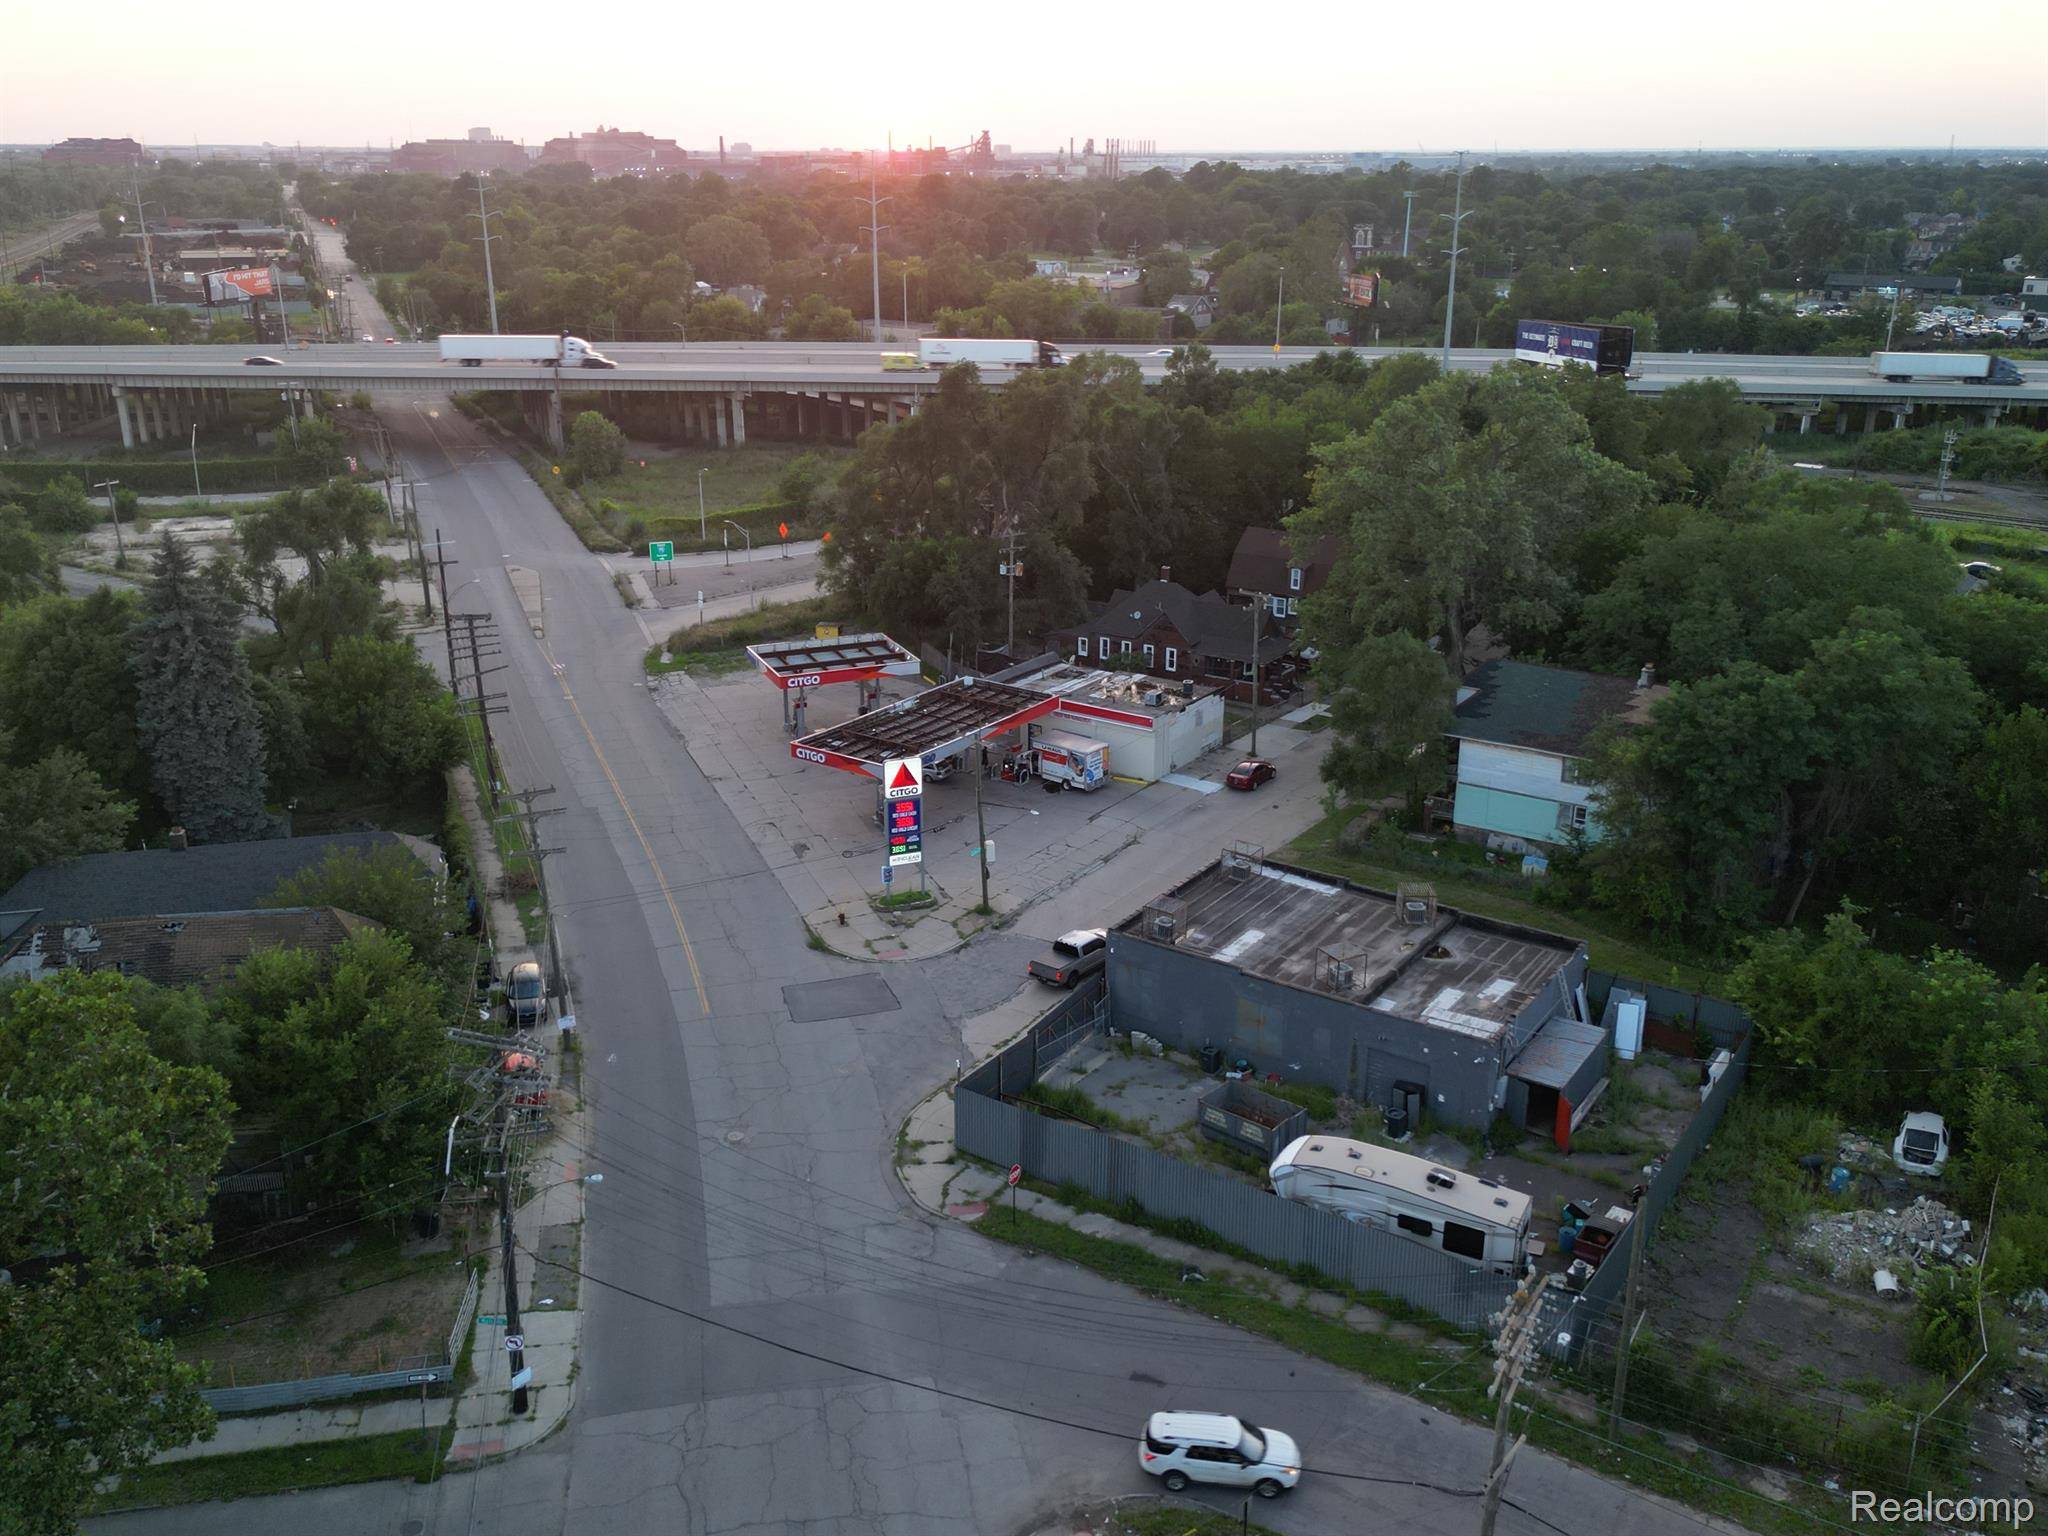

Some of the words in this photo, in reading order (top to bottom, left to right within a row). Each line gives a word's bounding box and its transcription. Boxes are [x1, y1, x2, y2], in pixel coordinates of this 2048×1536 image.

[788, 675, 820, 687] CITGO
[796, 748, 825, 763] CITGO
[890, 788, 918, 797] CITGO
